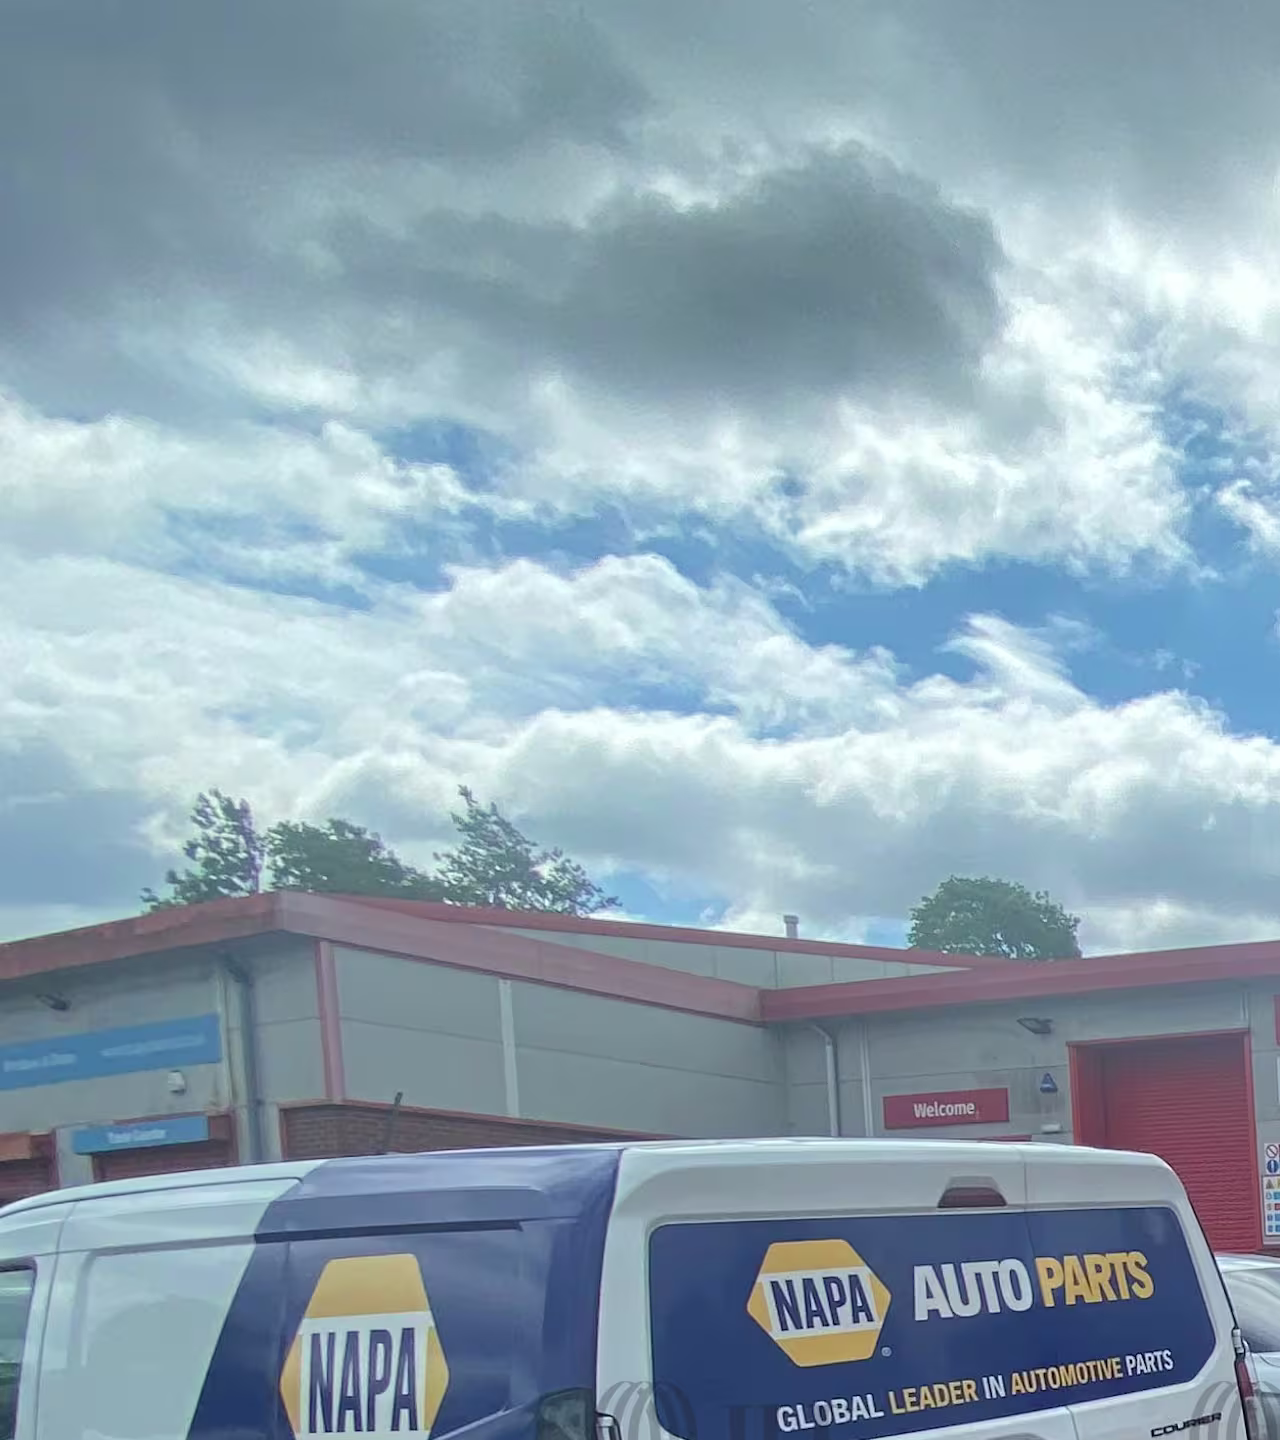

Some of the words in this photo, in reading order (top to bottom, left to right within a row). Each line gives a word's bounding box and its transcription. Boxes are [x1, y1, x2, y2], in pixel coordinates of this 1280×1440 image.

[913, 1101, 976, 1119] Welcome
[769, 1273, 874, 1332] NAPA
[913, 1257, 1034, 1321] AUTO
[1034, 1250, 1155, 1308] PARTS
[307, 1327, 419, 1434] NAPA
[776, 1393, 885, 1433] GLOBAL
[888, 1379, 979, 1415] LEADER
[981, 1375, 1006, 1399] IN
[1010, 1356, 1123, 1396] AUTOMOTIVE
[1125, 1349, 1174, 1377] PARTS
[1150, 1412, 1222, 1438] COURIER
